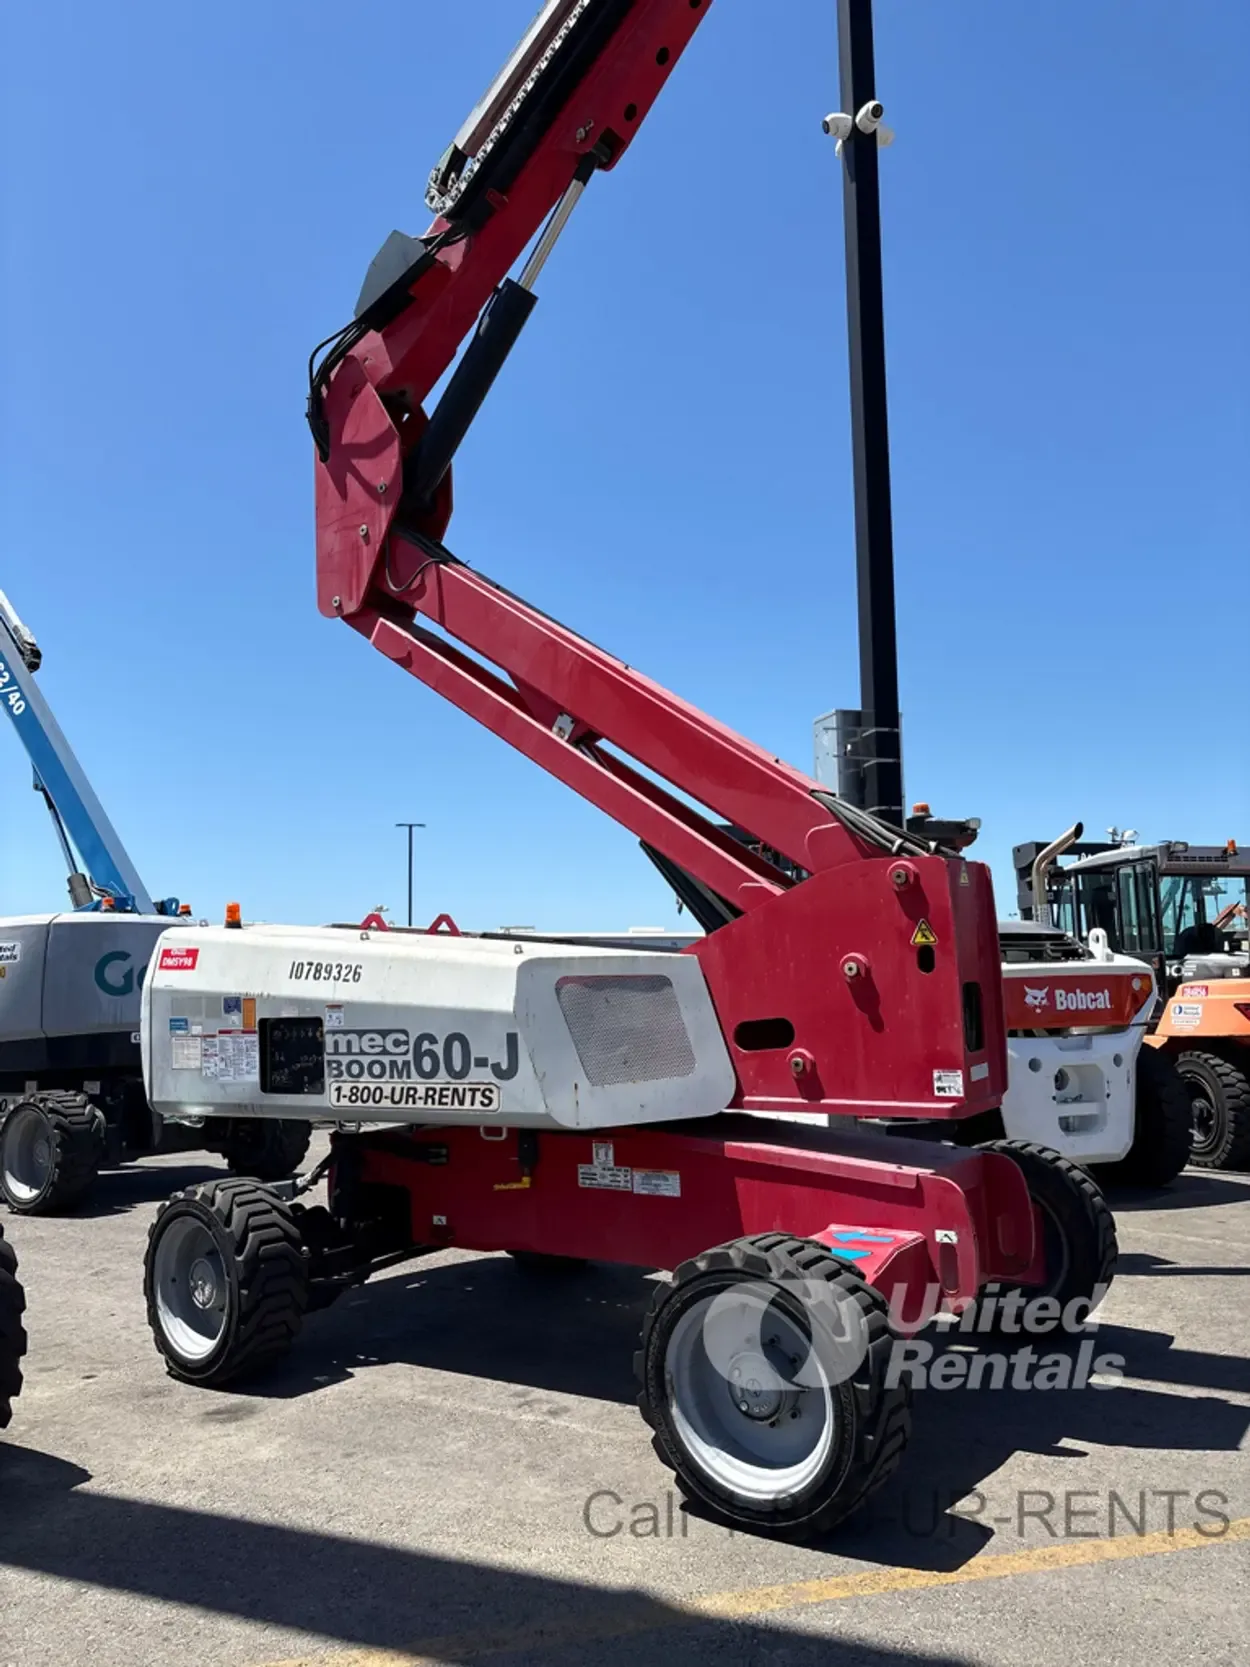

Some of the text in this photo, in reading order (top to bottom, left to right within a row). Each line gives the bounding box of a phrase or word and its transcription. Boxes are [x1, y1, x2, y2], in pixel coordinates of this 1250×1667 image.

[288, 961, 363, 983] 10789326
[1054, 988, 1111, 1010] Bobcat
[326, 1032, 409, 1054] mec
[326, 1032, 519, 1081] BOOM 60-J
[334, 1085, 494, 1108] 1-800-UR-RENTS
